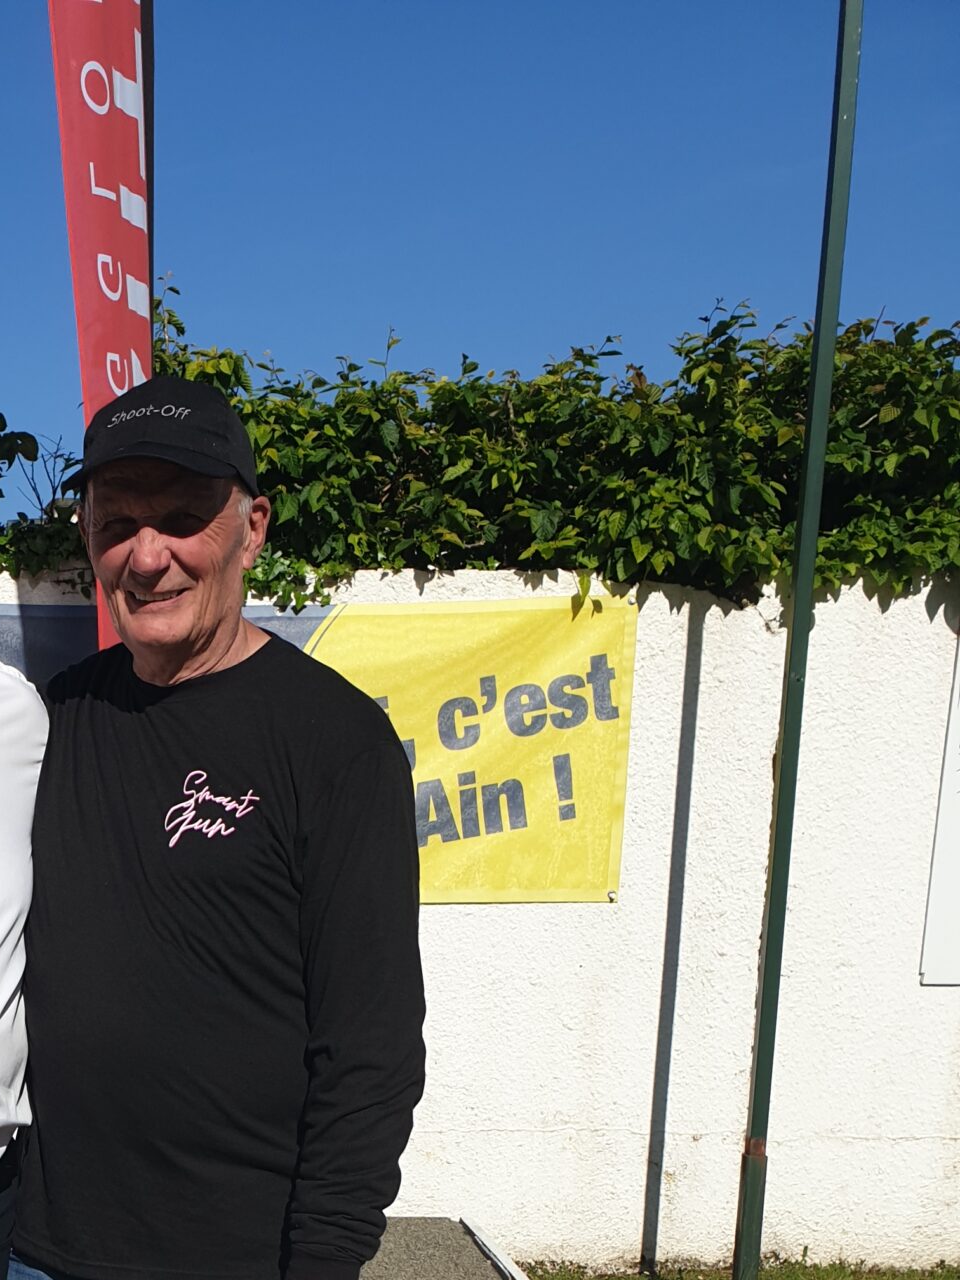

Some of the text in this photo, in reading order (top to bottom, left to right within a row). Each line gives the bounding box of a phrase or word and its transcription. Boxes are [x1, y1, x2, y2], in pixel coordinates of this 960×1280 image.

[106, 404, 191, 428] Shoot-Off
[437, 653, 620, 751] c'est
[182, 770, 260, 818] Smart
